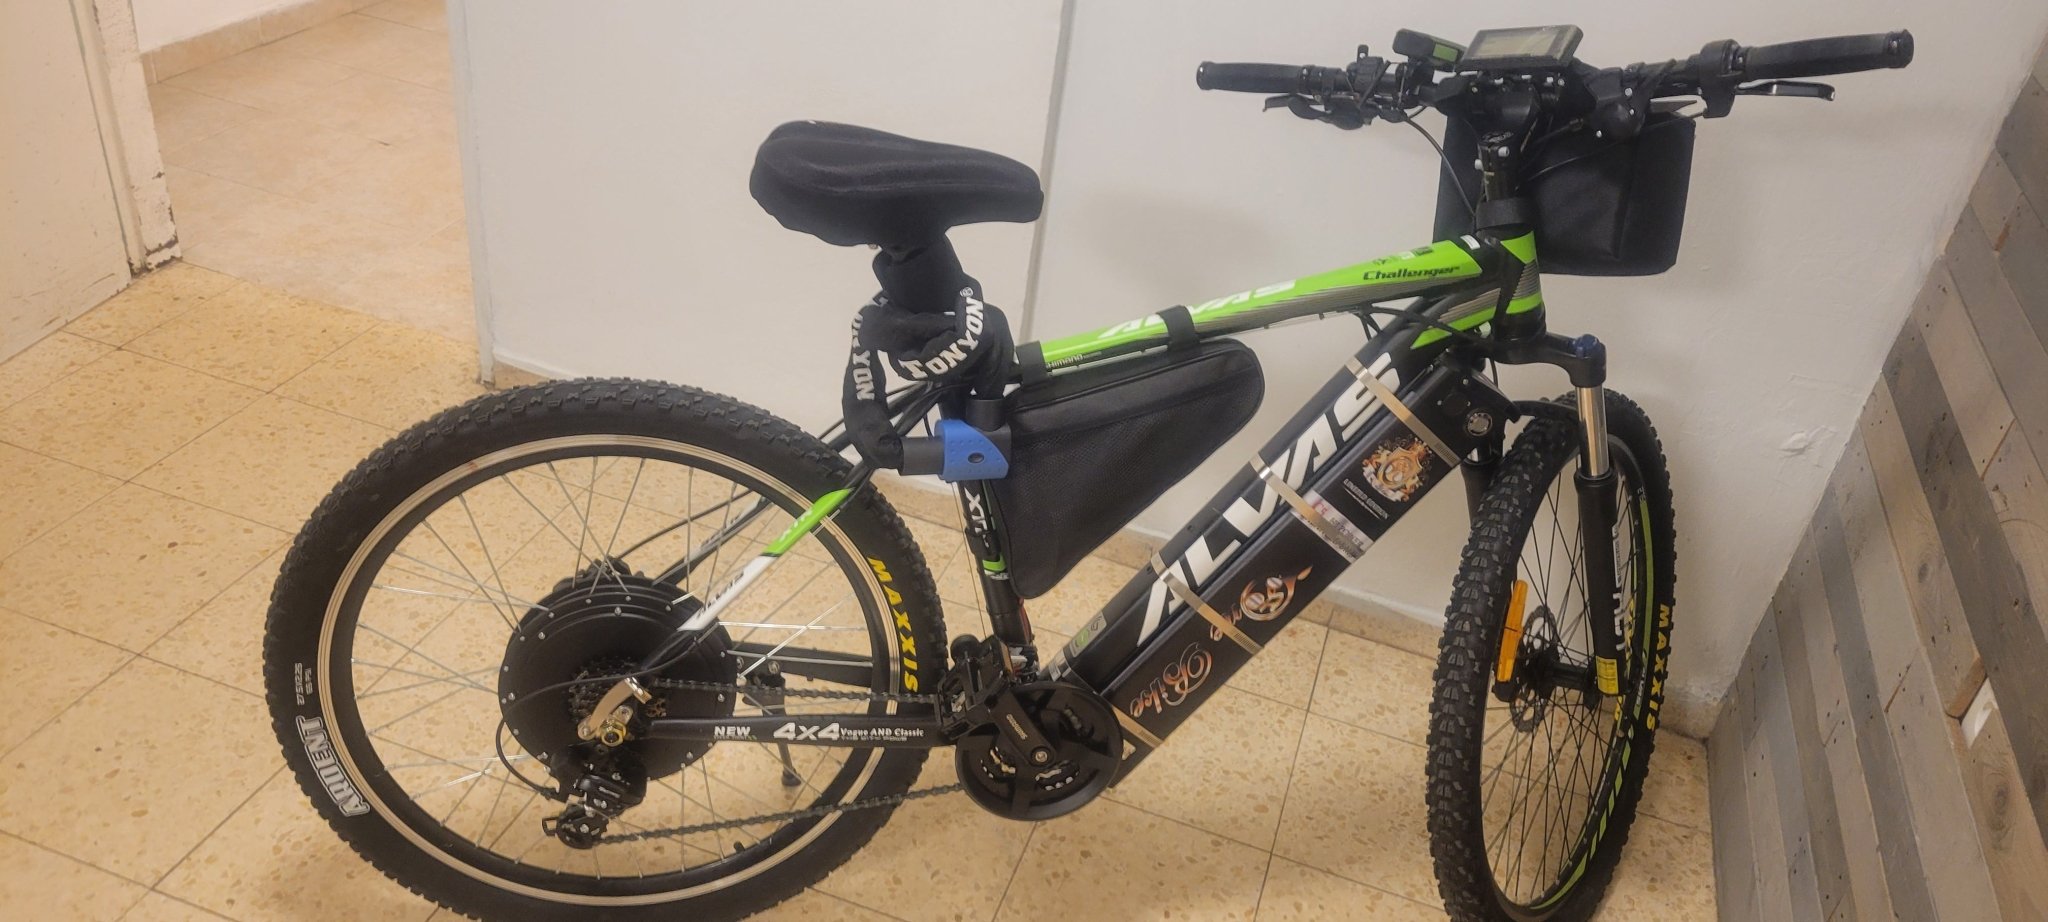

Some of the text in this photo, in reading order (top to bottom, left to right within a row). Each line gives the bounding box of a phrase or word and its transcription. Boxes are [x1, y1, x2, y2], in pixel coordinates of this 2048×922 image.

[1362, 265, 1460, 281] Challenger
[1137, 352, 1401, 648] ALVAS
[867, 556, 918, 692] MAXXIS
[1646, 603, 1670, 731] MAXXIS
[1130, 641, 1213, 718] Bike
[296, 715, 371, 817] ARDENT
[714, 726, 751, 736] NEW
[869, 727, 892, 736] AND
